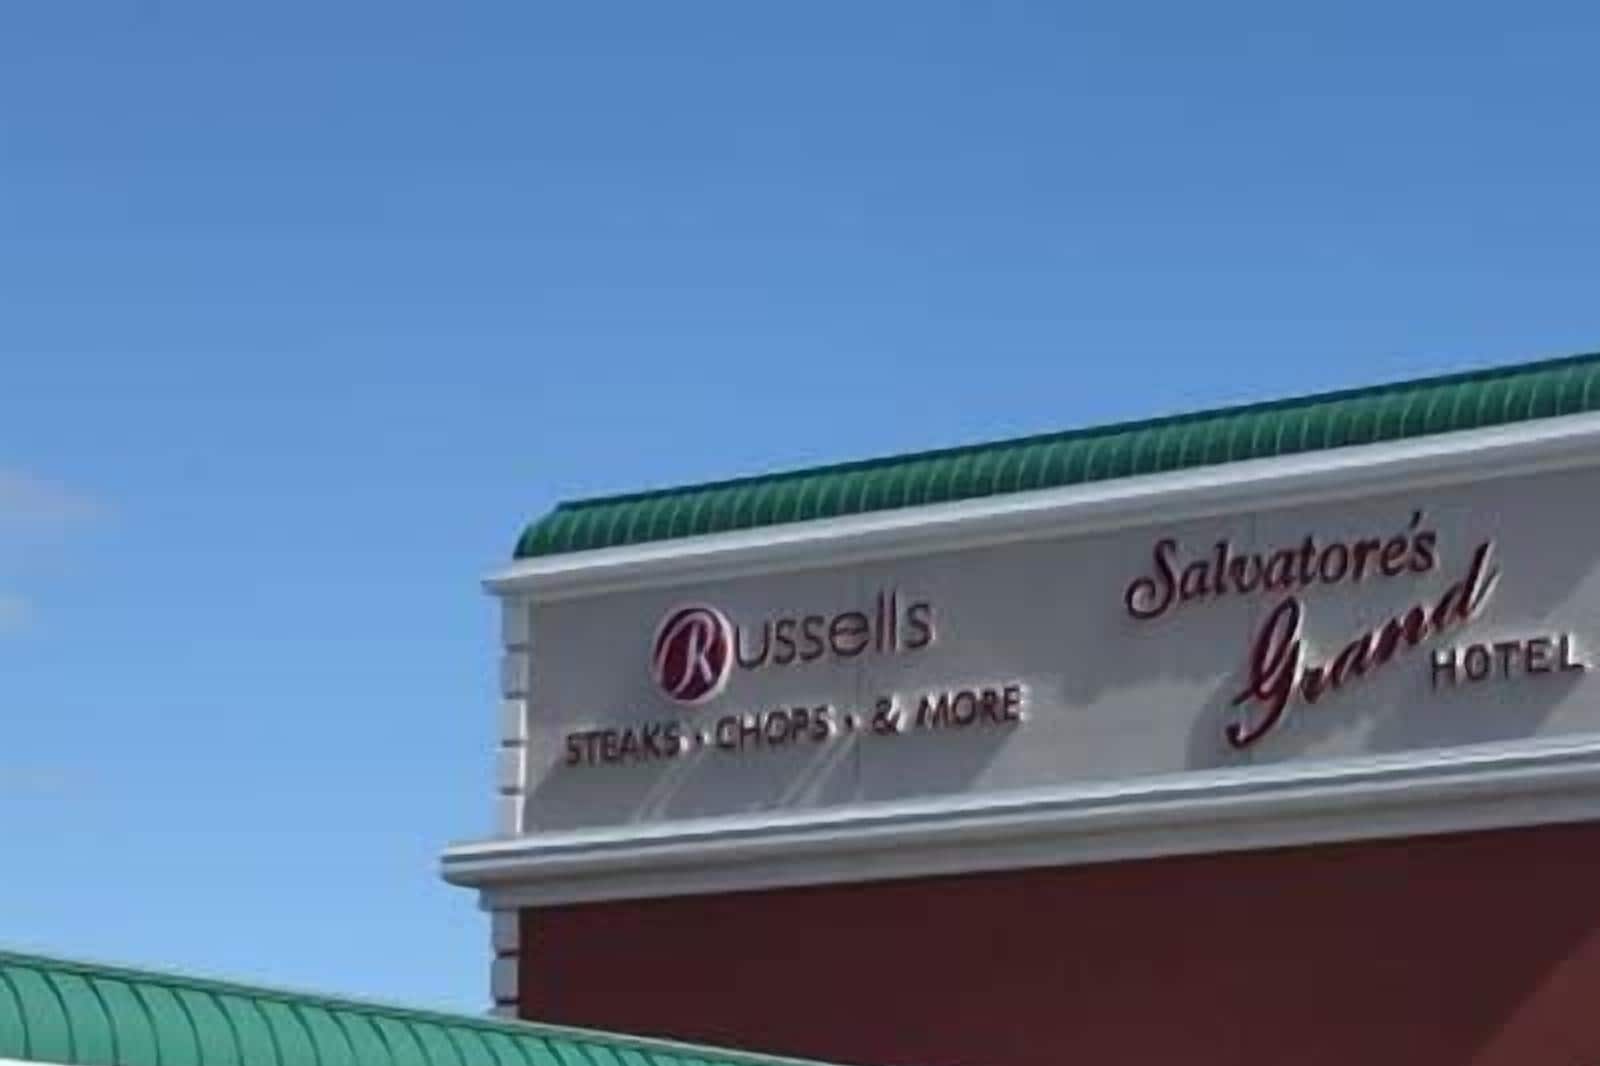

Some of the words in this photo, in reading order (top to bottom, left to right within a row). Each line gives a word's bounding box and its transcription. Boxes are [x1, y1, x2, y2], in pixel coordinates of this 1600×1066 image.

[1125, 511, 1437, 620] Salvatore's
[1226, 541, 1493, 749] Grand
[1431, 634, 1585, 690] HOTEL
[566, 722, 682, 766] STEAKS
[715, 706, 832, 751] CHOPS
[873, 697, 899, 736] &
[916, 684, 1021, 728] MORE
